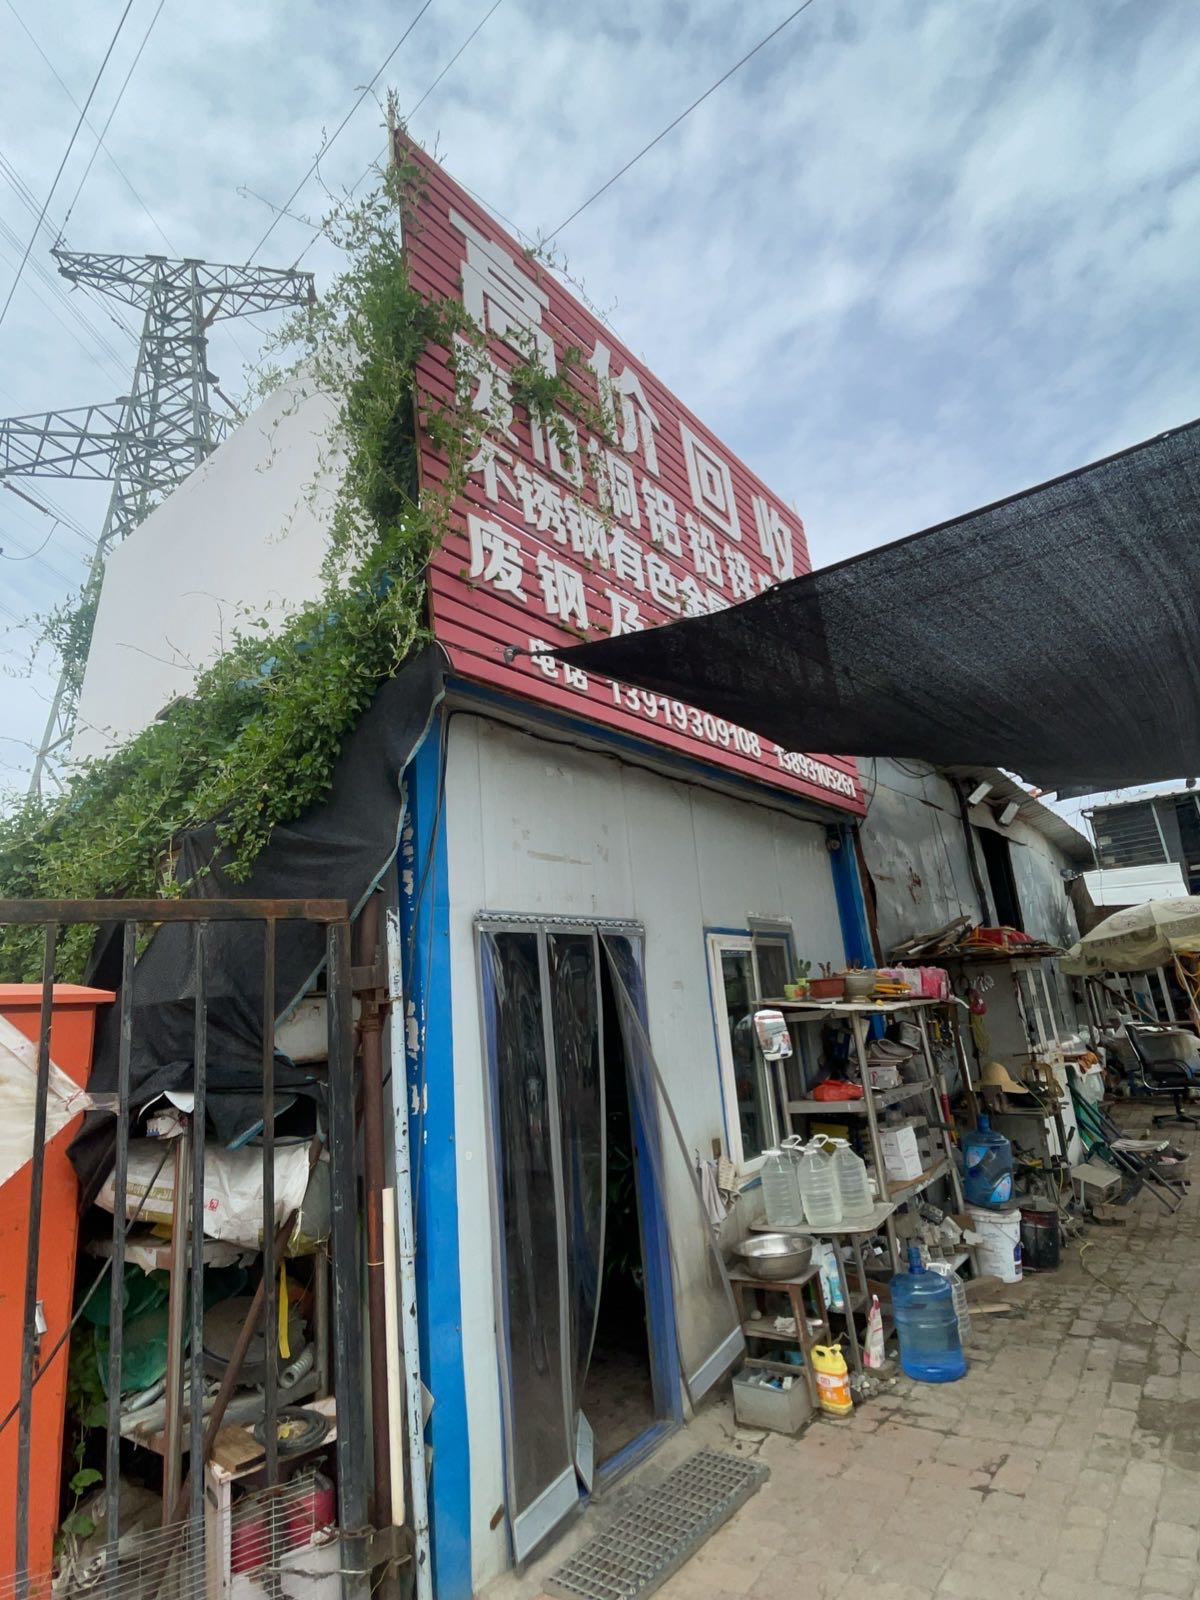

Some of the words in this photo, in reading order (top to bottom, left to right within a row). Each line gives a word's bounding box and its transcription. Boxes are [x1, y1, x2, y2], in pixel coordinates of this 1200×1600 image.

[448, 208, 795, 582] 高价回收
[606, 678, 762, 758] 13919309108
[772, 744, 857, 798] 13893105261
